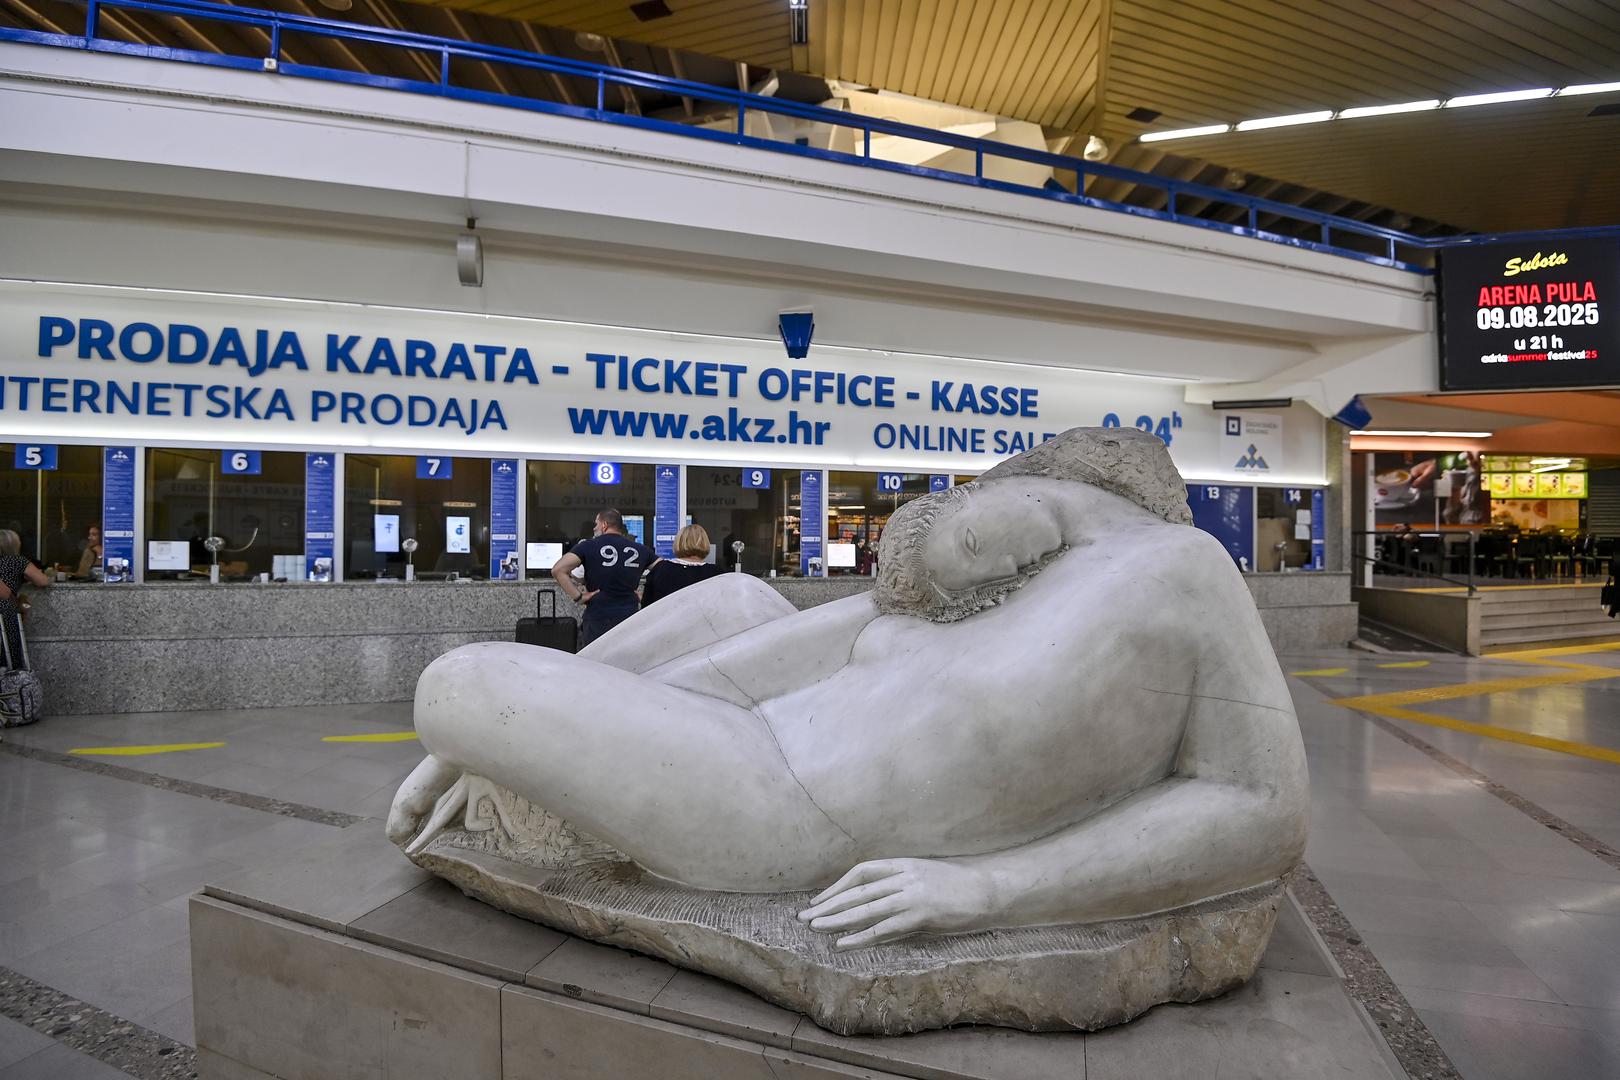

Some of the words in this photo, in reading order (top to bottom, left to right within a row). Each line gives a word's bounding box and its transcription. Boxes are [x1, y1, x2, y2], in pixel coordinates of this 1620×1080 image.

[1503, 251, 1569, 277] Subota
[1478, 284, 1542, 306] ARENA
[1547, 281, 1597, 303] PULA
[1477, 303, 1600, 330] 09.08.2025
[1514, 338, 1527, 350] u
[1530, 336, 1548, 350] 21
[1552, 335, 1564, 349] h
[1481, 350, 1598, 364] adriasummerfestival25
[39, 316, 308, 377] PRODAJA
[327, 334, 539, 385] KARATA
[553, 366, 570, 375] -
[586, 353, 748, 398] TICKET
[759, 368, 897, 408] OFFICE
[906, 392, 919, 400] -
[932, 380, 1038, 418] KASSE
[0, 375, 294, 421] TERNETSKA
[311, 390, 509, 437] PRODAJA
[568, 407, 831, 447] www.akz.hr
[874, 422, 986, 453] ONLINE
[26, 447, 42, 466] 5
[232, 452, 248, 471] 6
[427, 458, 441, 475] 7
[599, 463, 614, 483] 8
[750, 470, 763, 486] 9
[882, 475, 901, 490] 10
[1207, 486, 1220, 499] 13
[1288, 490, 1302, 502] 14
[600, 545, 640, 568] 92
